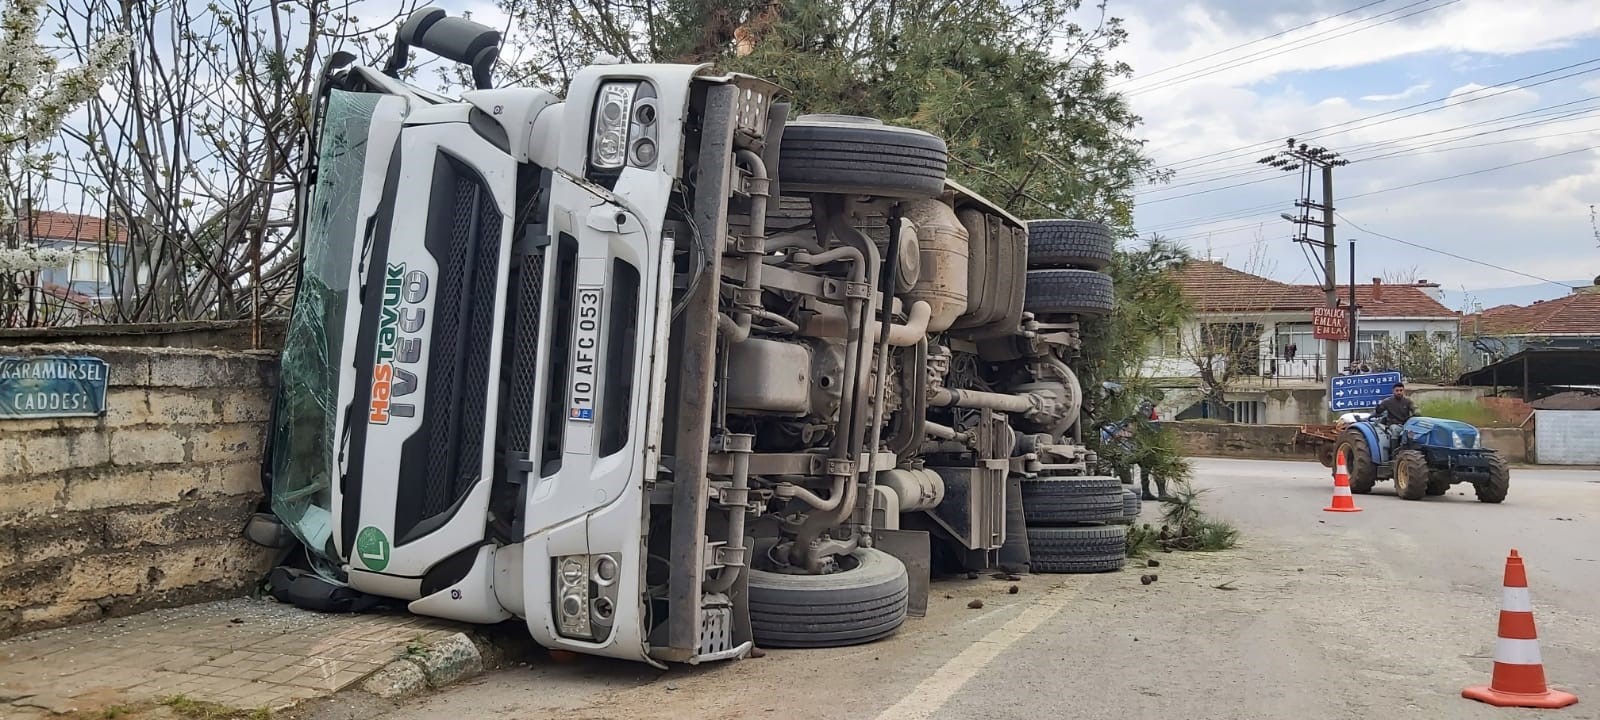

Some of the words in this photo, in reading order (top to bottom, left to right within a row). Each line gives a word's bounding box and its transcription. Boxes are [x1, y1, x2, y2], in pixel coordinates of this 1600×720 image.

[579, 293, 598, 331] 053
[1314, 316, 1342, 327] EMLAK
[390, 270, 429, 418] IVECO
[576, 338, 595, 375] AFC
[1346, 375, 1396, 385] Orhangazi
[574, 382, 592, 404] 10
[1347, 387, 1381, 395] Yalova
[582, 410, 589, 418] TR
[362, 541, 385, 560] L
